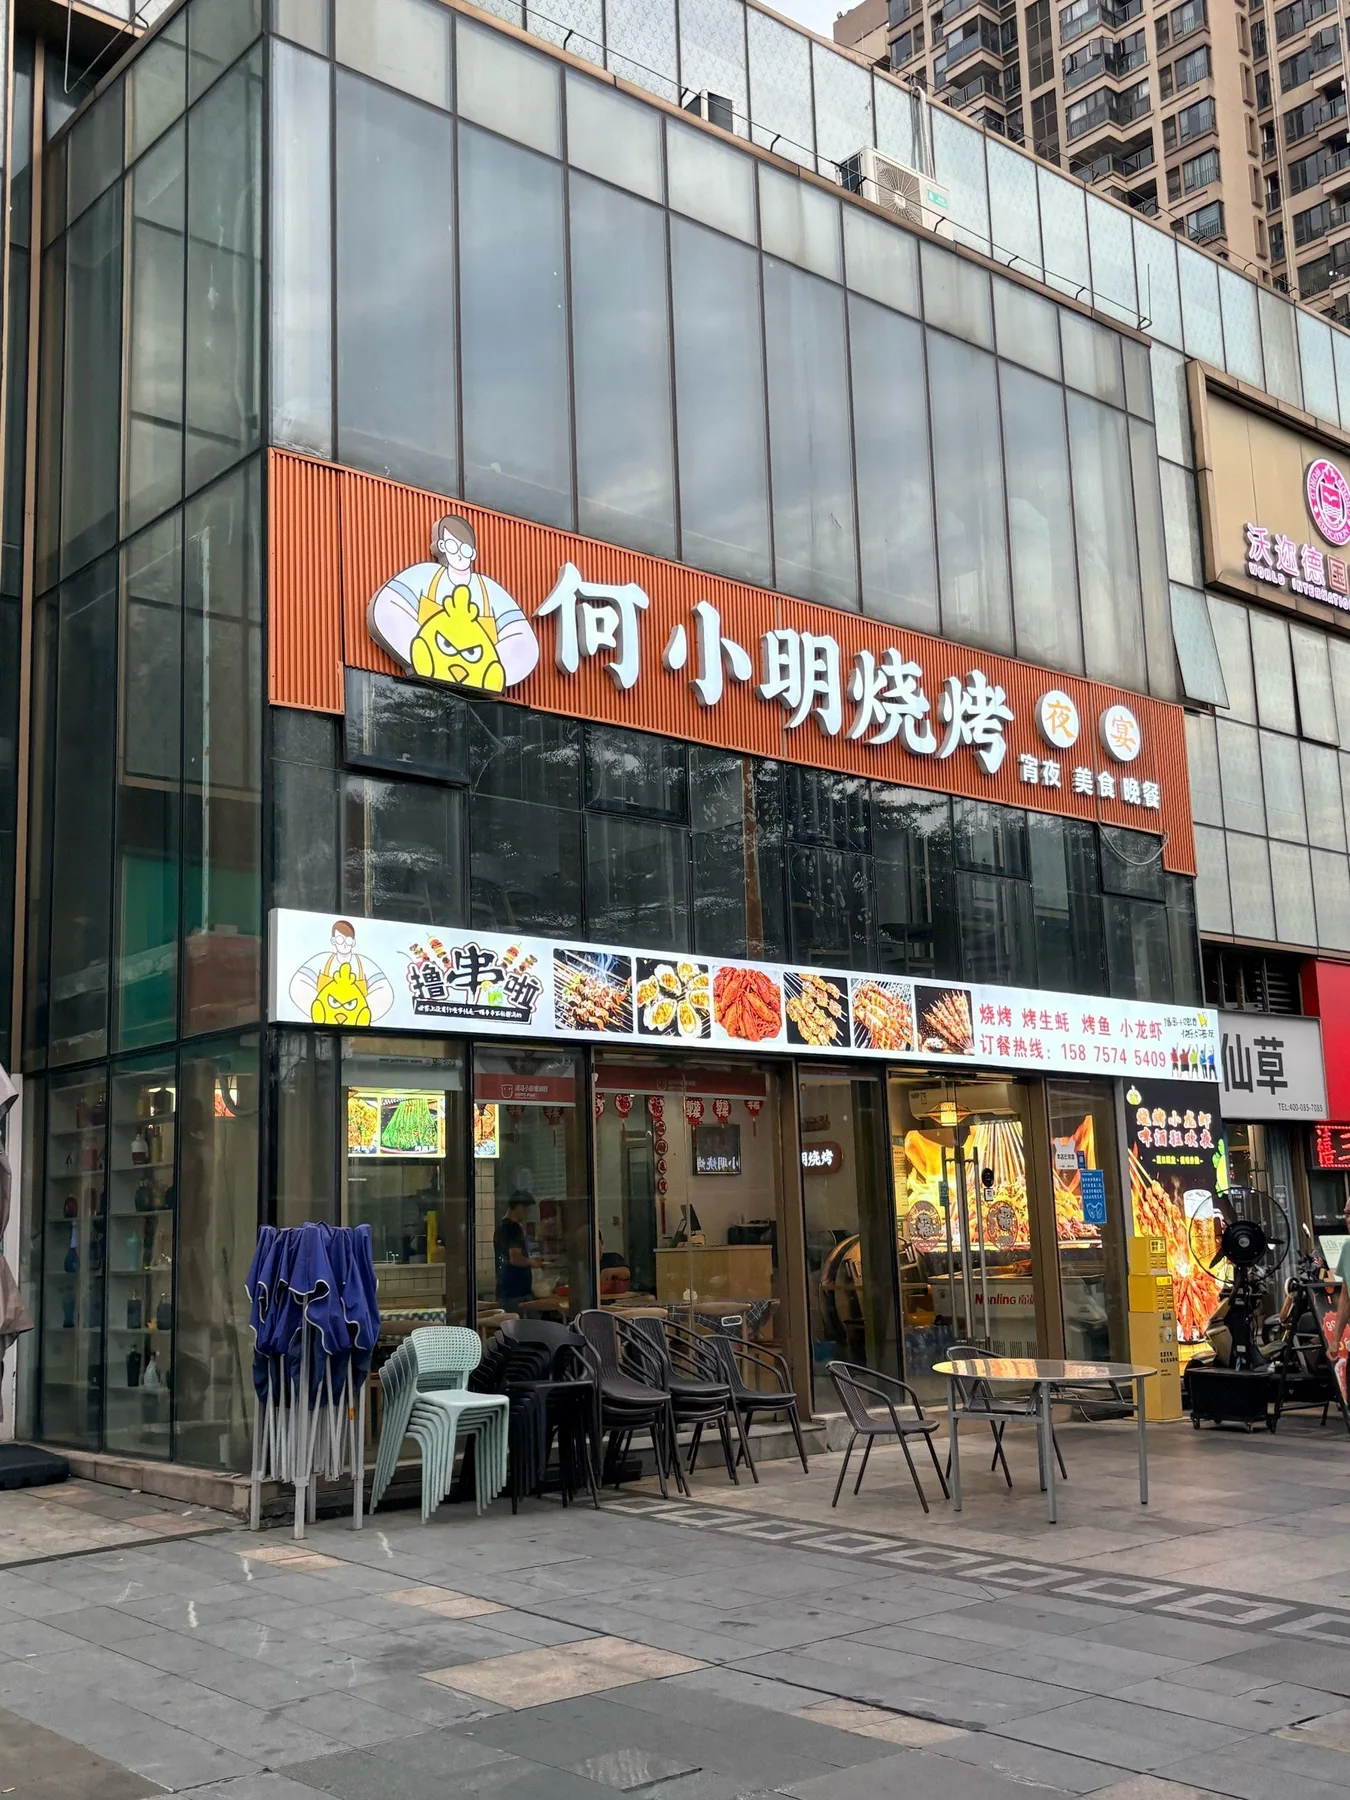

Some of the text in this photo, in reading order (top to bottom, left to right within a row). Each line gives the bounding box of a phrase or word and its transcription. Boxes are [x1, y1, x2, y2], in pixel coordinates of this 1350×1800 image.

[1248, 562, 1286, 586] WORLD
[534, 561, 1014, 775] 何小明烧烤
[1018, 753, 1061, 789] 宵夜
[1121, 777, 1161, 810] 晚餐
[409, 943, 542, 1009] 撸串啦
[979, 1003, 1012, 1028] 烧烤
[1021, 1008, 1070, 1033] 烤生蚝
[1081, 1013, 1111, 1036] 烤鱼
[1120, 1018, 1163, 1042] 小龙虾
[1061, 1042, 1086, 1061] 158
[1094, 1045, 1127, 1065] 7574
[1134, 1048, 1166, 1068] 5409
[1221, 1033, 1289, 1096] 仙草
